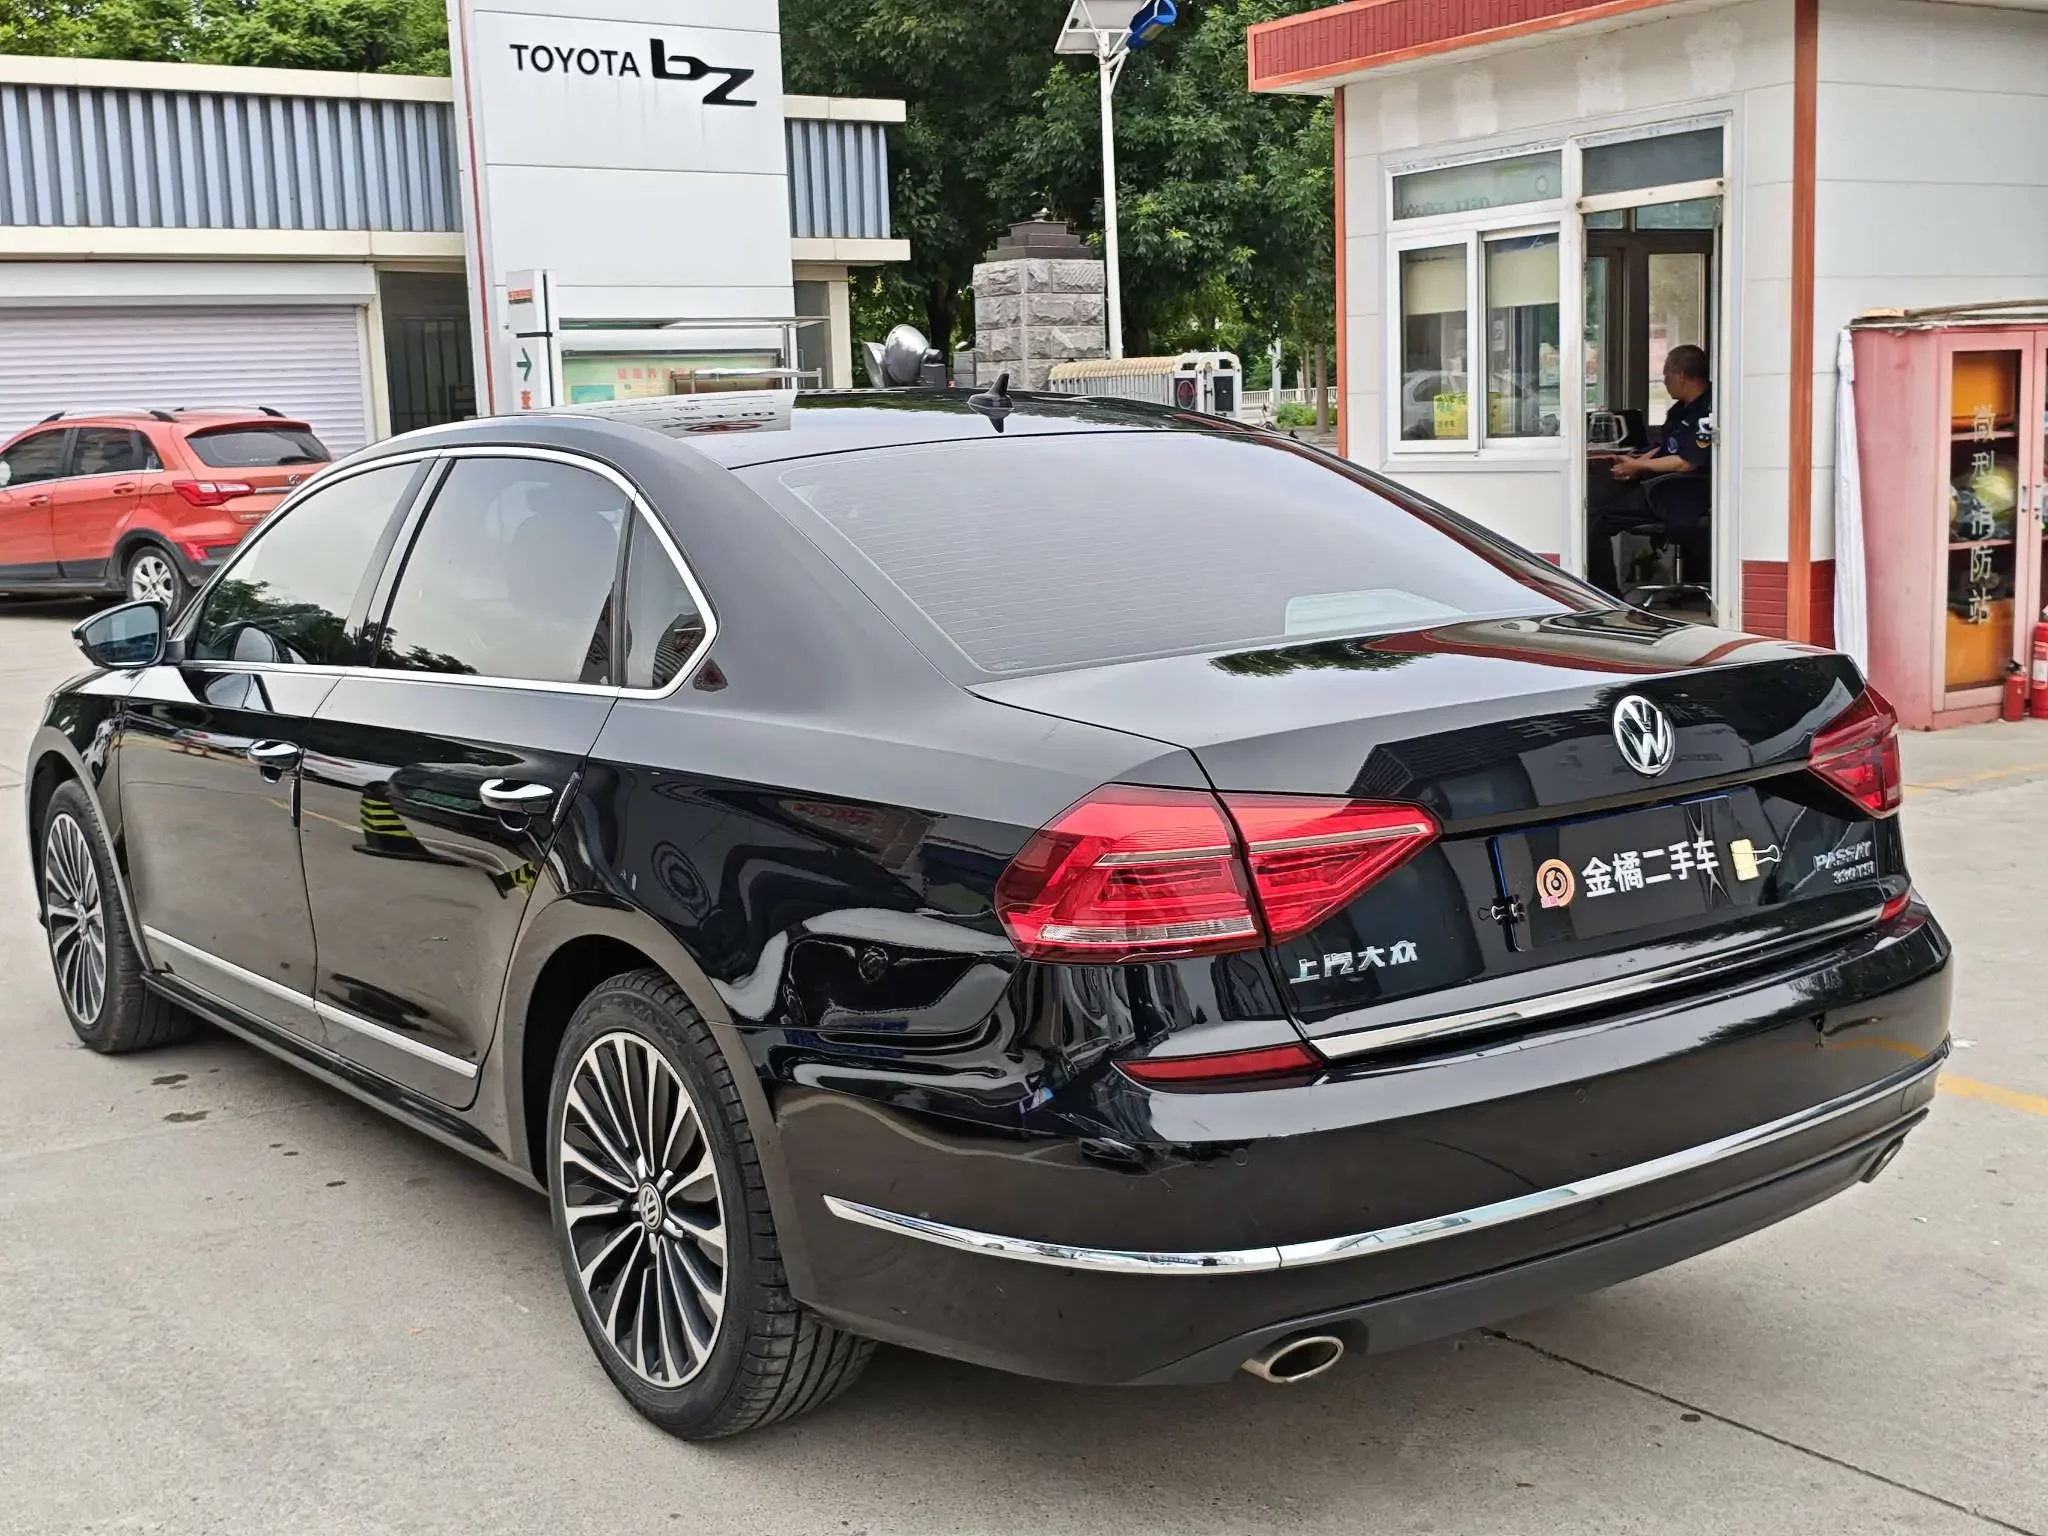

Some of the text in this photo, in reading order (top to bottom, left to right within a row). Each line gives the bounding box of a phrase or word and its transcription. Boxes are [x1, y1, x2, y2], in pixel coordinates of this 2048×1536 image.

[509, 43, 641, 78] TOYOTA
[1968, 403, 1997, 626] 微型消防站
[1581, 836, 1720, 898] 金橘二手车
[1812, 840, 1872, 872] PASSAT
[1289, 939, 1418, 984] 上汽大众
